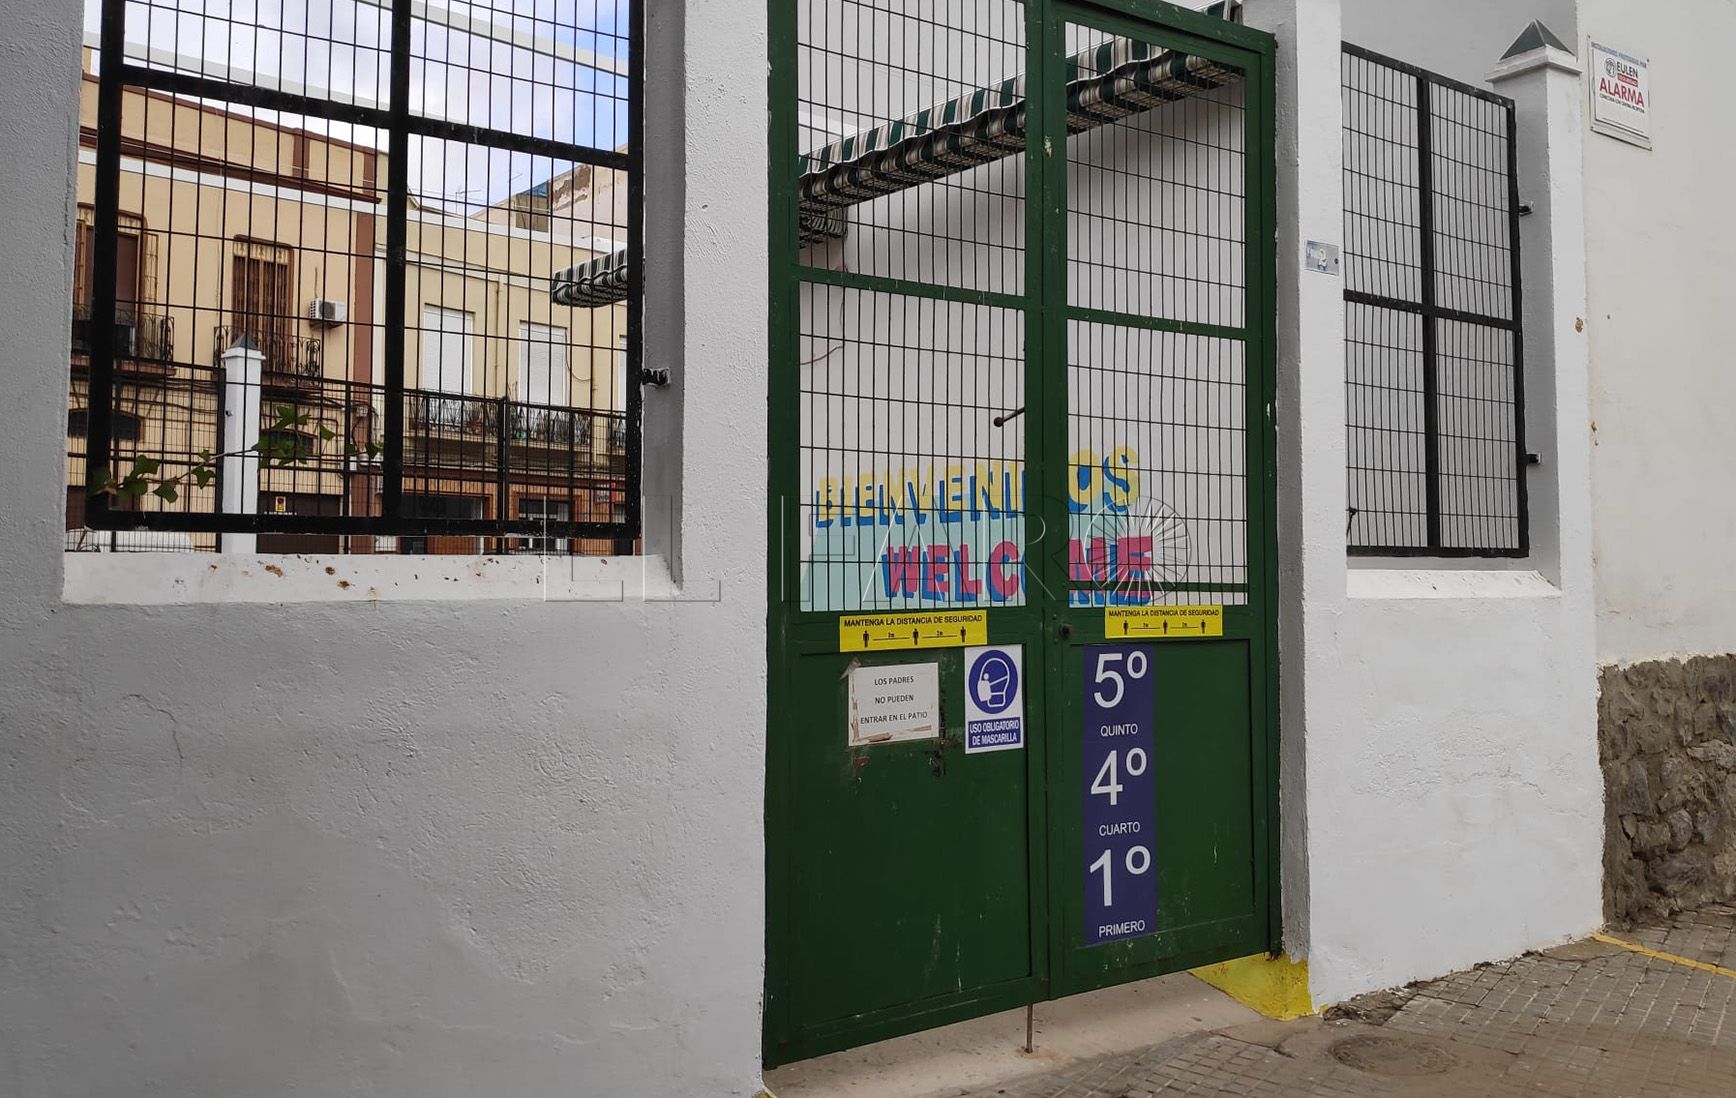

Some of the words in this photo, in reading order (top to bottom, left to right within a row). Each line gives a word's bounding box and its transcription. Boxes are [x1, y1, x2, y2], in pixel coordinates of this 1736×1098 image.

[1616, 61, 1639, 78] EULEN
[1600, 77, 1645, 108] ALARMA
[815, 445, 1140, 528] BIENVENIOS
[882, 534, 1154, 606] WELCME
[844, 617, 884, 627] MANTENGA
[886, 617, 895, 625] LA
[896, 616, 932, 625] DISTANCIA
[934, 615, 943, 624] DE
[944, 614, 982, 623] SEGURIDAD
[874, 678, 887, 686] LOS
[889, 676, 914, 685] PADRES
[874, 696, 886, 705] NO
[887, 694, 914, 703] PUEDEN
[860, 715, 887, 725] ENTRAR
[889, 714, 898, 722] EN
[899, 713, 907, 721] EL
[908, 711, 928, 720] PATIO
[970, 723, 982, 733] USO
[982, 719, 1020, 732] OBLIGATORIO
[1100, 723, 1138, 737] QUINTO
[972, 735, 981, 746] DE
[982, 732, 1018, 744] MASCARILLA
[1099, 821, 1141, 836] CUARTO
[1098, 919, 1146, 938] PRIMERO
